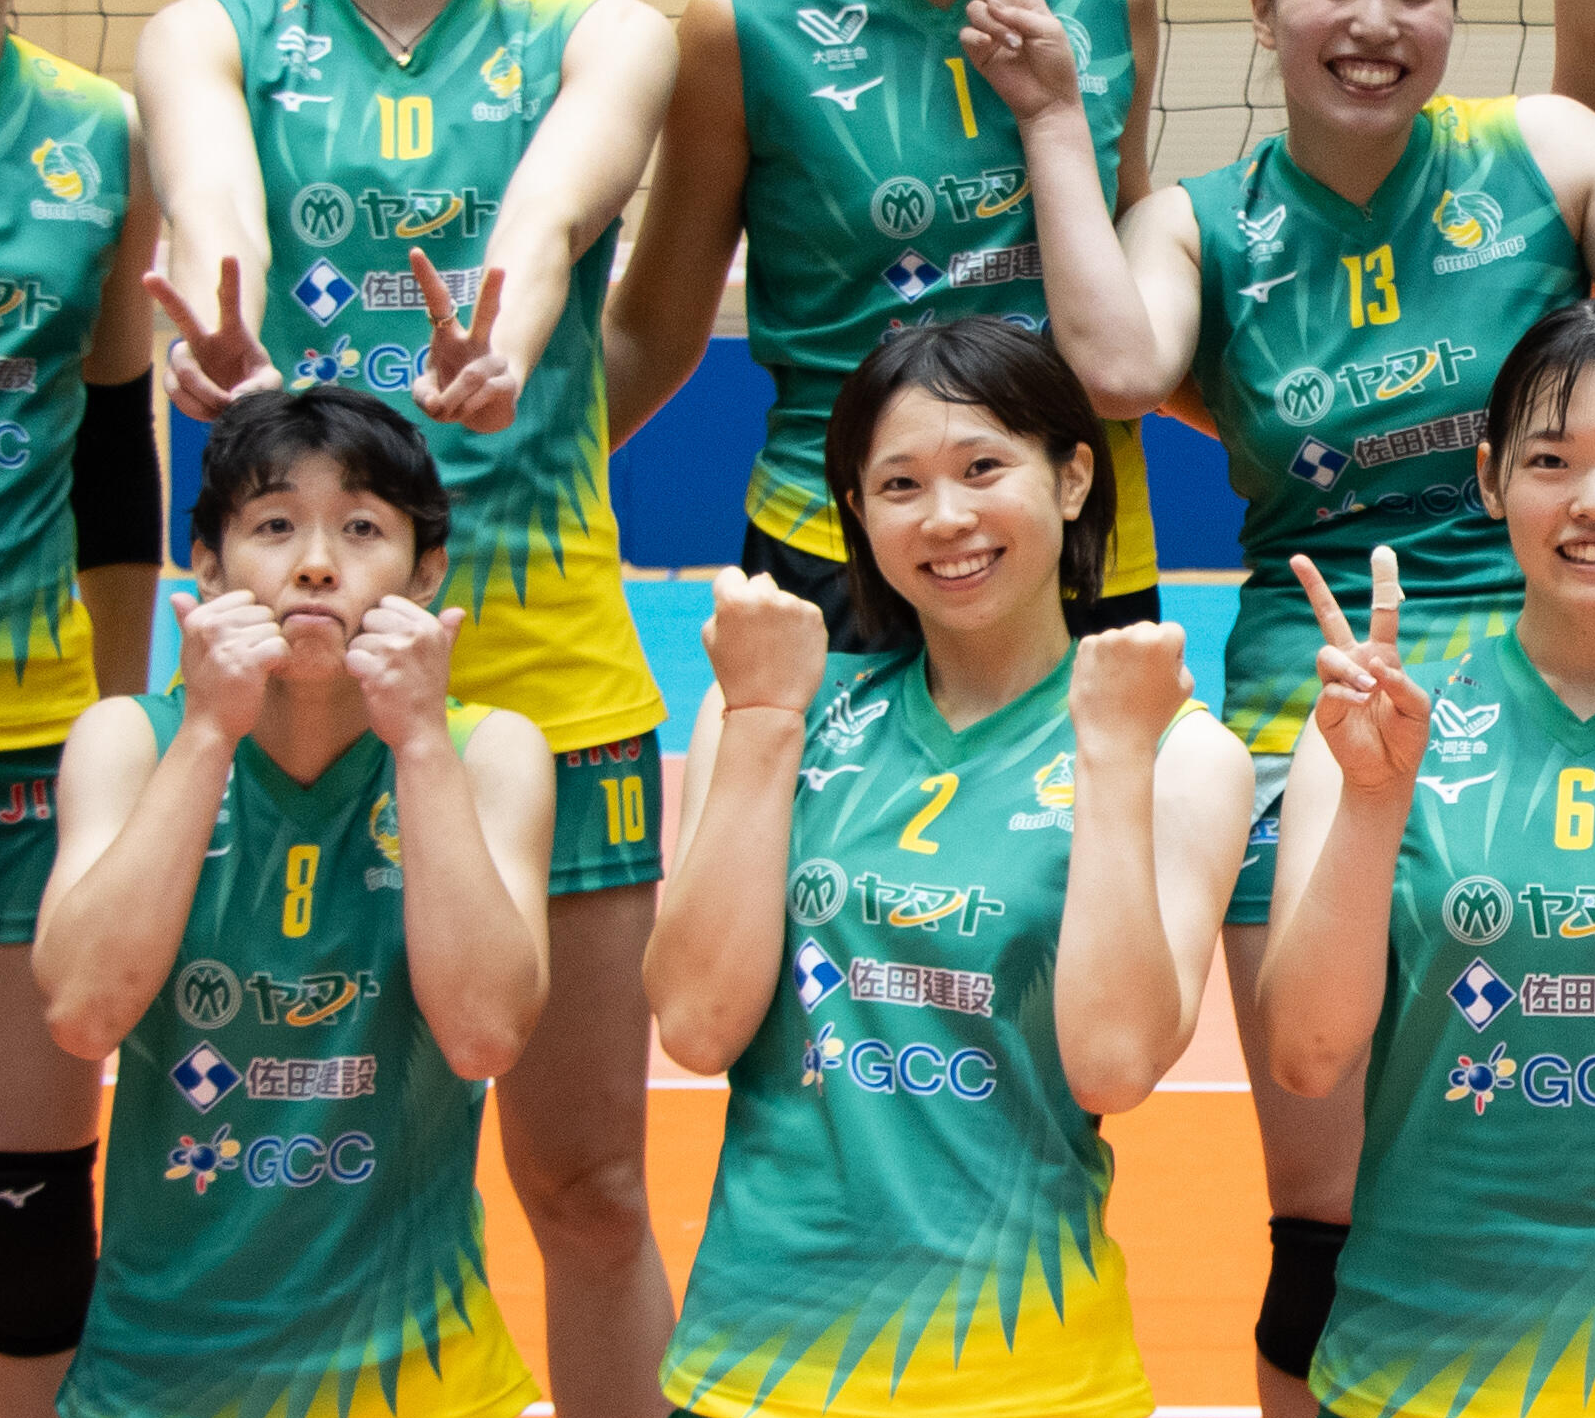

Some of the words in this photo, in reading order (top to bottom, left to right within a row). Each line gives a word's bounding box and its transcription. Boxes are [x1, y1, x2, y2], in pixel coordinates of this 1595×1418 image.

[376, 94, 434, 161] 10
[945, 58, 978, 139] 1
[935, 166, 1033, 223] ヤマ
[1341, 244, 1400, 329] 13
[1336, 339, 1476, 407] ヤマト
[598, 775, 645, 845] 10
[898, 772, 960, 855] 2
[282, 845, 320, 938] 8
[854, 871, 1005, 937] ヤマト
[247, 970, 380, 1026] ヤマト
[848, 956, 995, 1018] 佐田建設
[246, 1055, 377, 1102] 佐田建設
[847, 1039, 997, 1101] GCC
[246, 1130, 377, 1188] GCC
